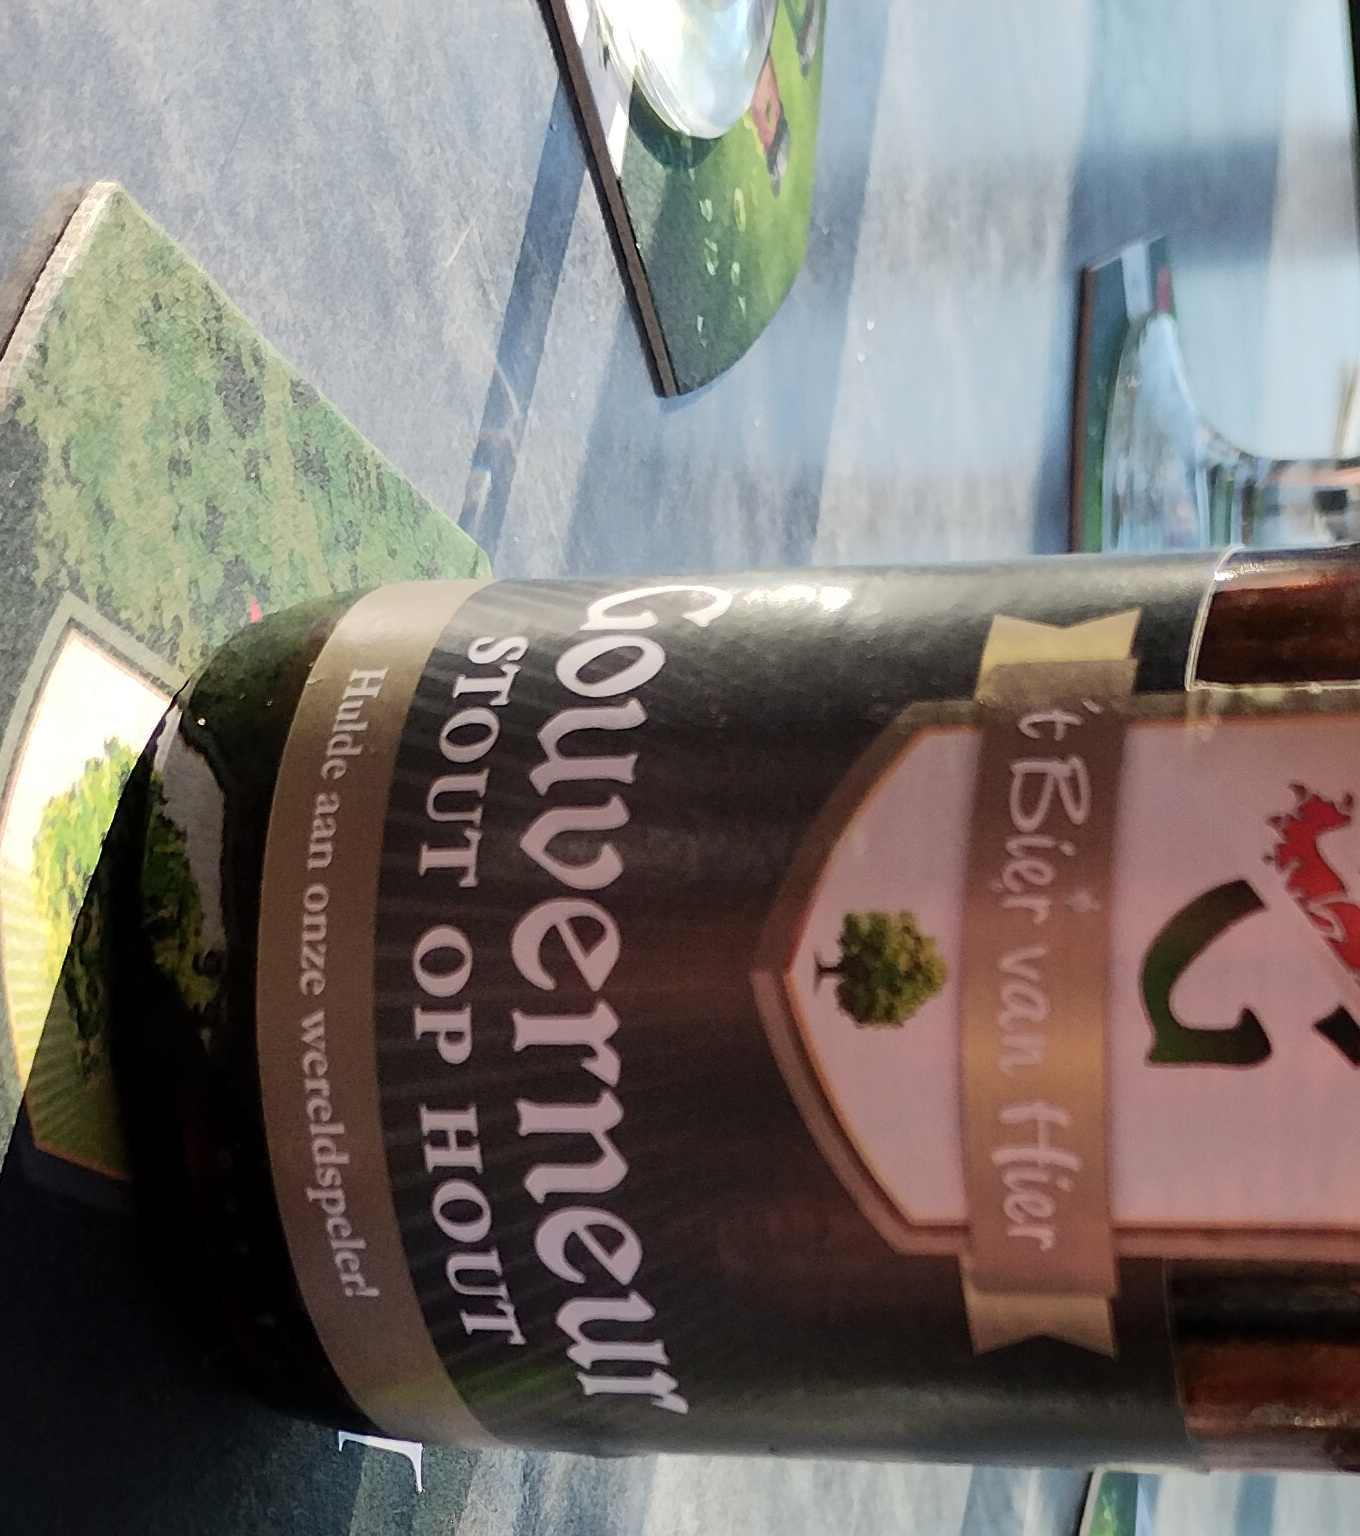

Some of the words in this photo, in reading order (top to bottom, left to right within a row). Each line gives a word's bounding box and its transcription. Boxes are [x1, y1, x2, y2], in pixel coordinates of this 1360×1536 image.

[320, 667, 388, 781] Hulde
[415, 635, 529, 889] STOUT
[1016, 698, 1103, 742] 't
[305, 790, 341, 872] aan
[999, 755, 1092, 925] Bier
[288, 882, 330, 996] onze
[411, 924, 473, 1065] OP
[509, 584, 733, 1414] Gouverneur
[996, 943, 1051, 1078] van
[302, 1009, 381, 1298] wereldspeler!
[418, 1104, 526, 1346] HOUT
[989, 1100, 1083, 1250] Hier
